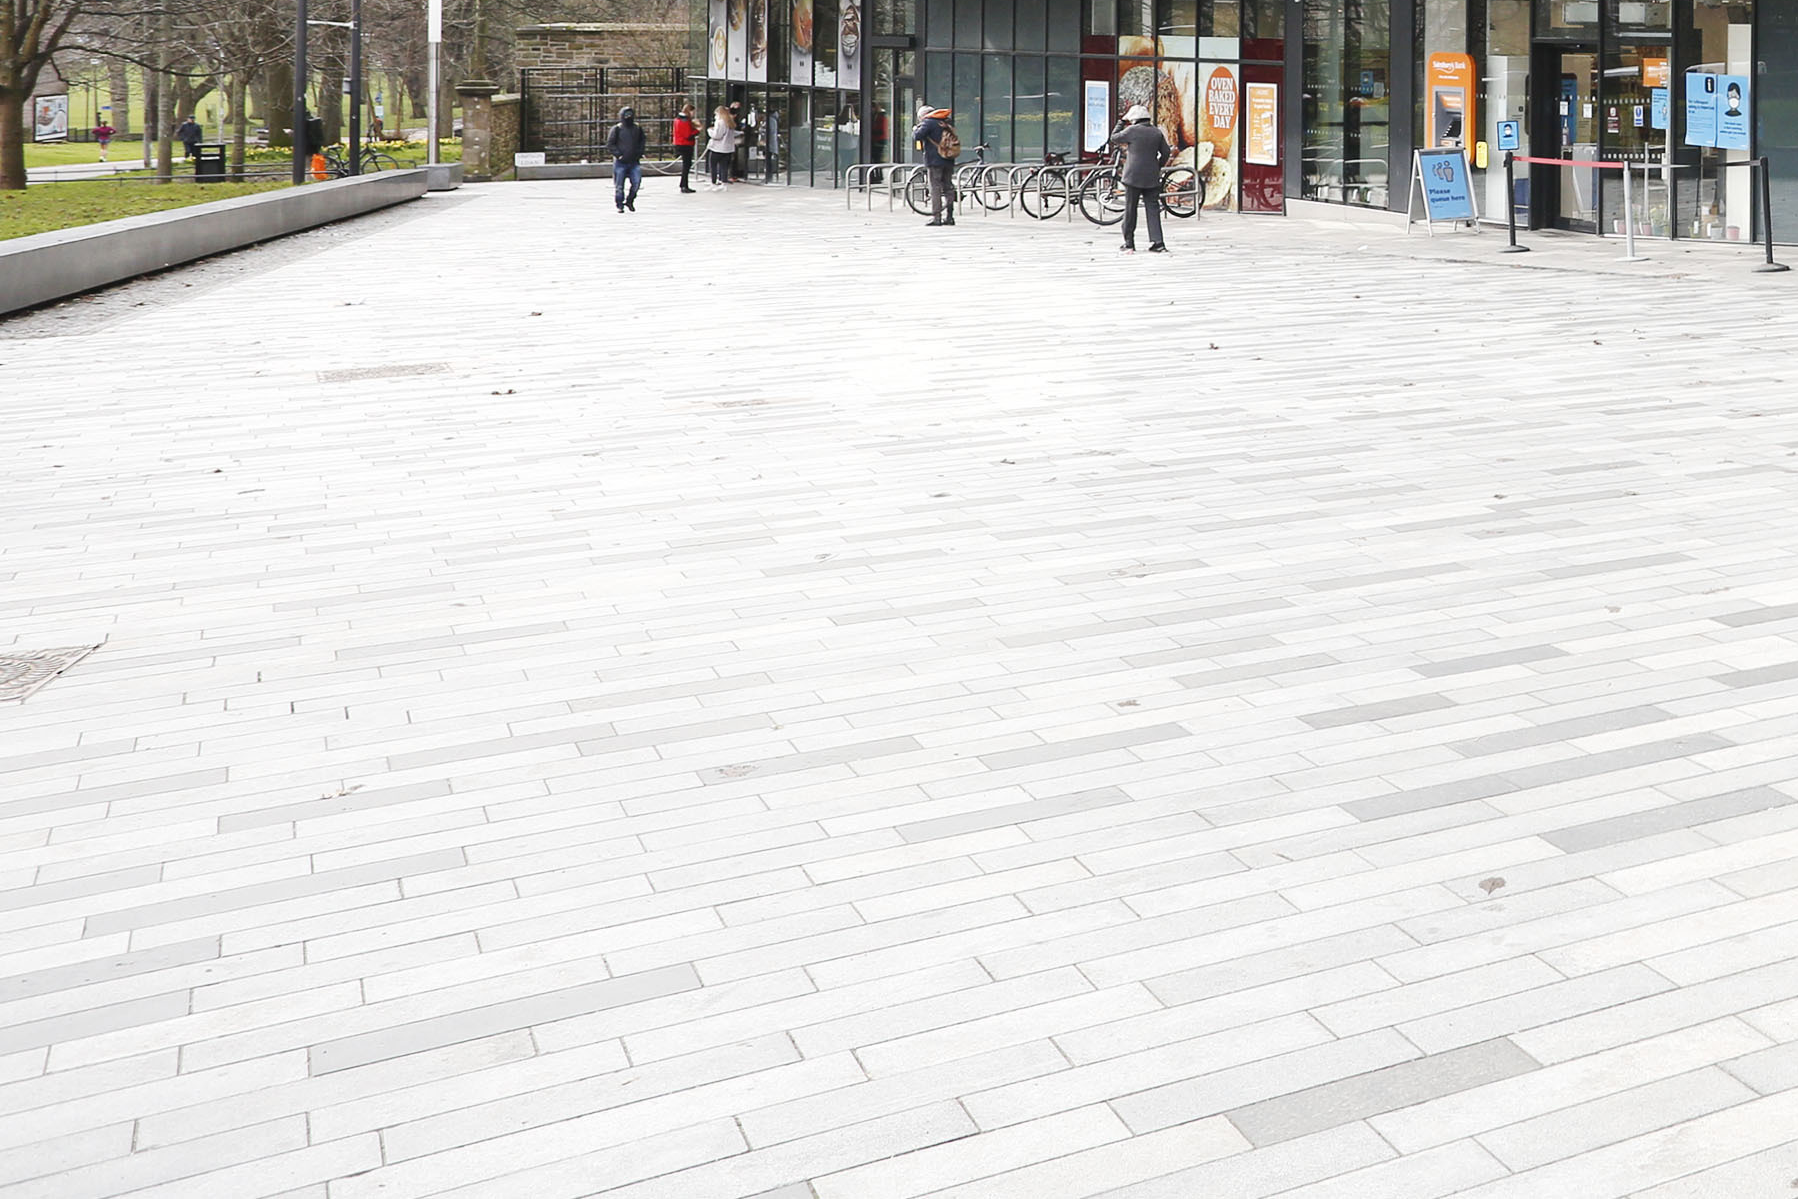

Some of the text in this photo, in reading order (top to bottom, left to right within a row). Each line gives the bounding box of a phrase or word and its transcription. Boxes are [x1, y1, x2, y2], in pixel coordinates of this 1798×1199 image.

[1211, 76, 1233, 90] OVEN
[1208, 89, 1236, 103] BAKED
[1209, 102, 1235, 116] EVERY
[1213, 115, 1231, 129] DAY
